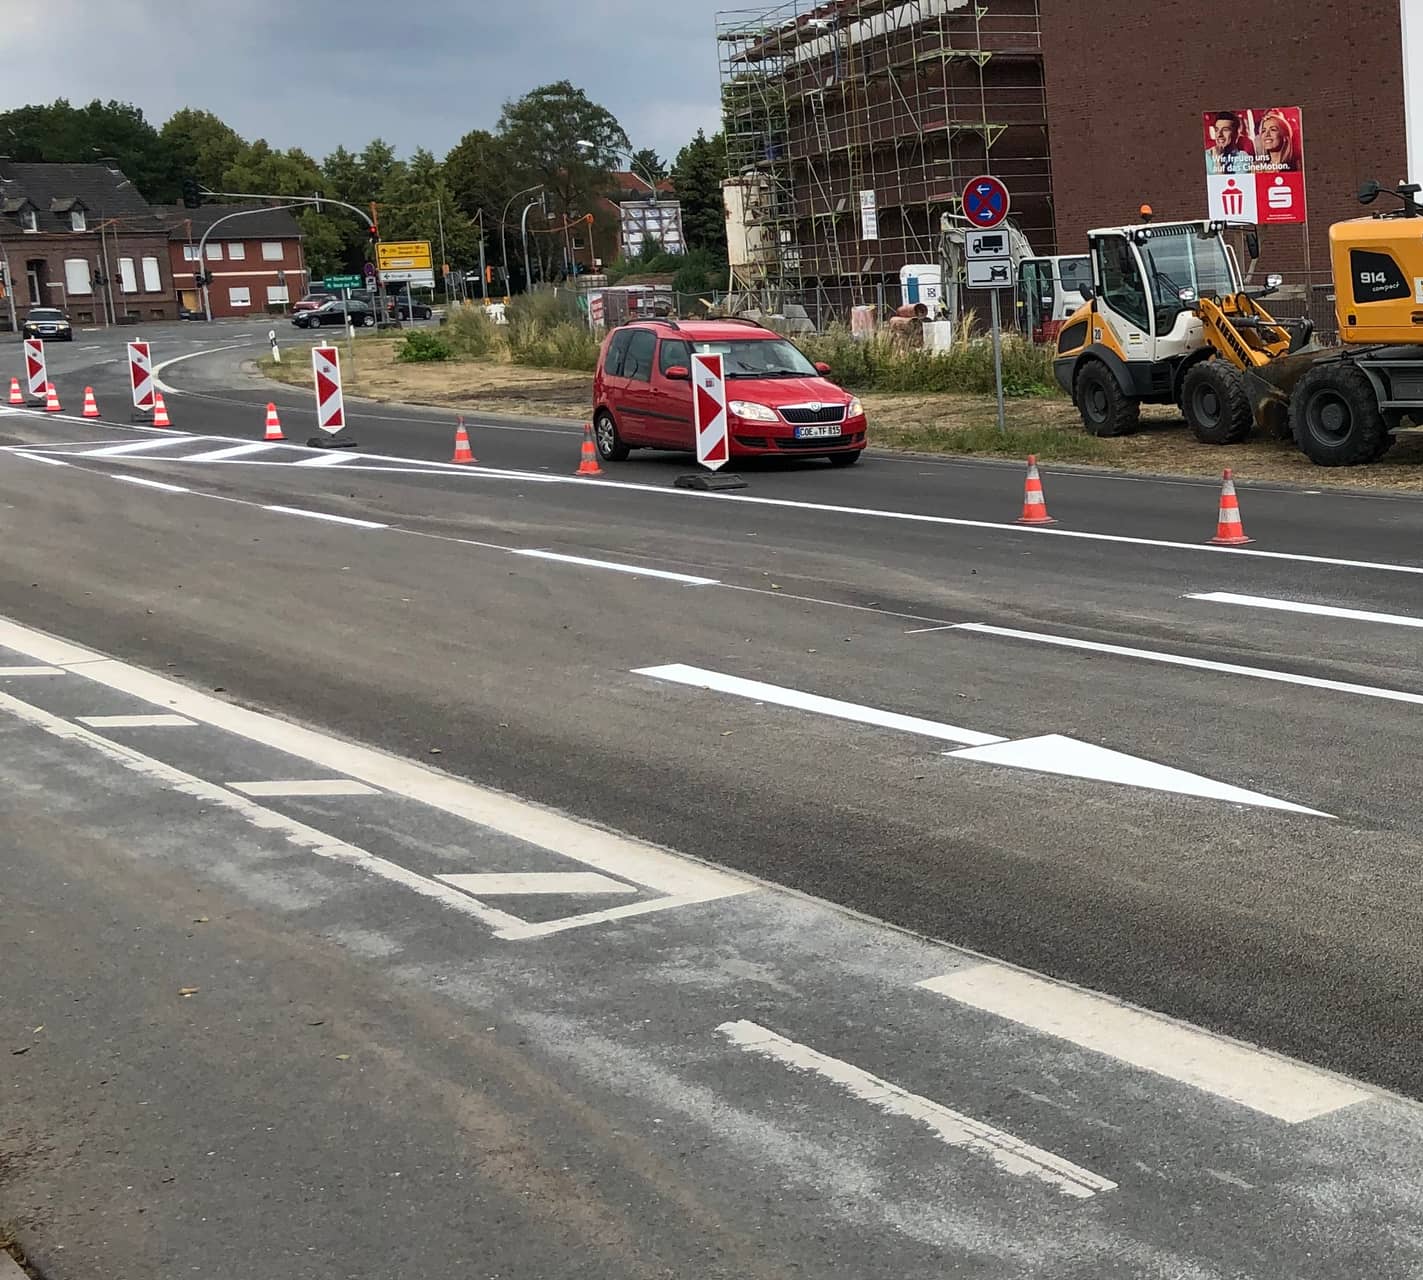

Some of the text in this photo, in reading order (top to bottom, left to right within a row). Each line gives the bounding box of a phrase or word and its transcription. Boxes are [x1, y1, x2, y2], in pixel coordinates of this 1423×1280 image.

[1228, 154, 1254, 162] freuen
[1213, 164, 1226, 172] auf
[1242, 162, 1291, 171] CineMotion.
[1360, 272, 1386, 283] 914
[1372, 281, 1400, 292] compact
[1215, 316, 1253, 367] LIEBHERR
